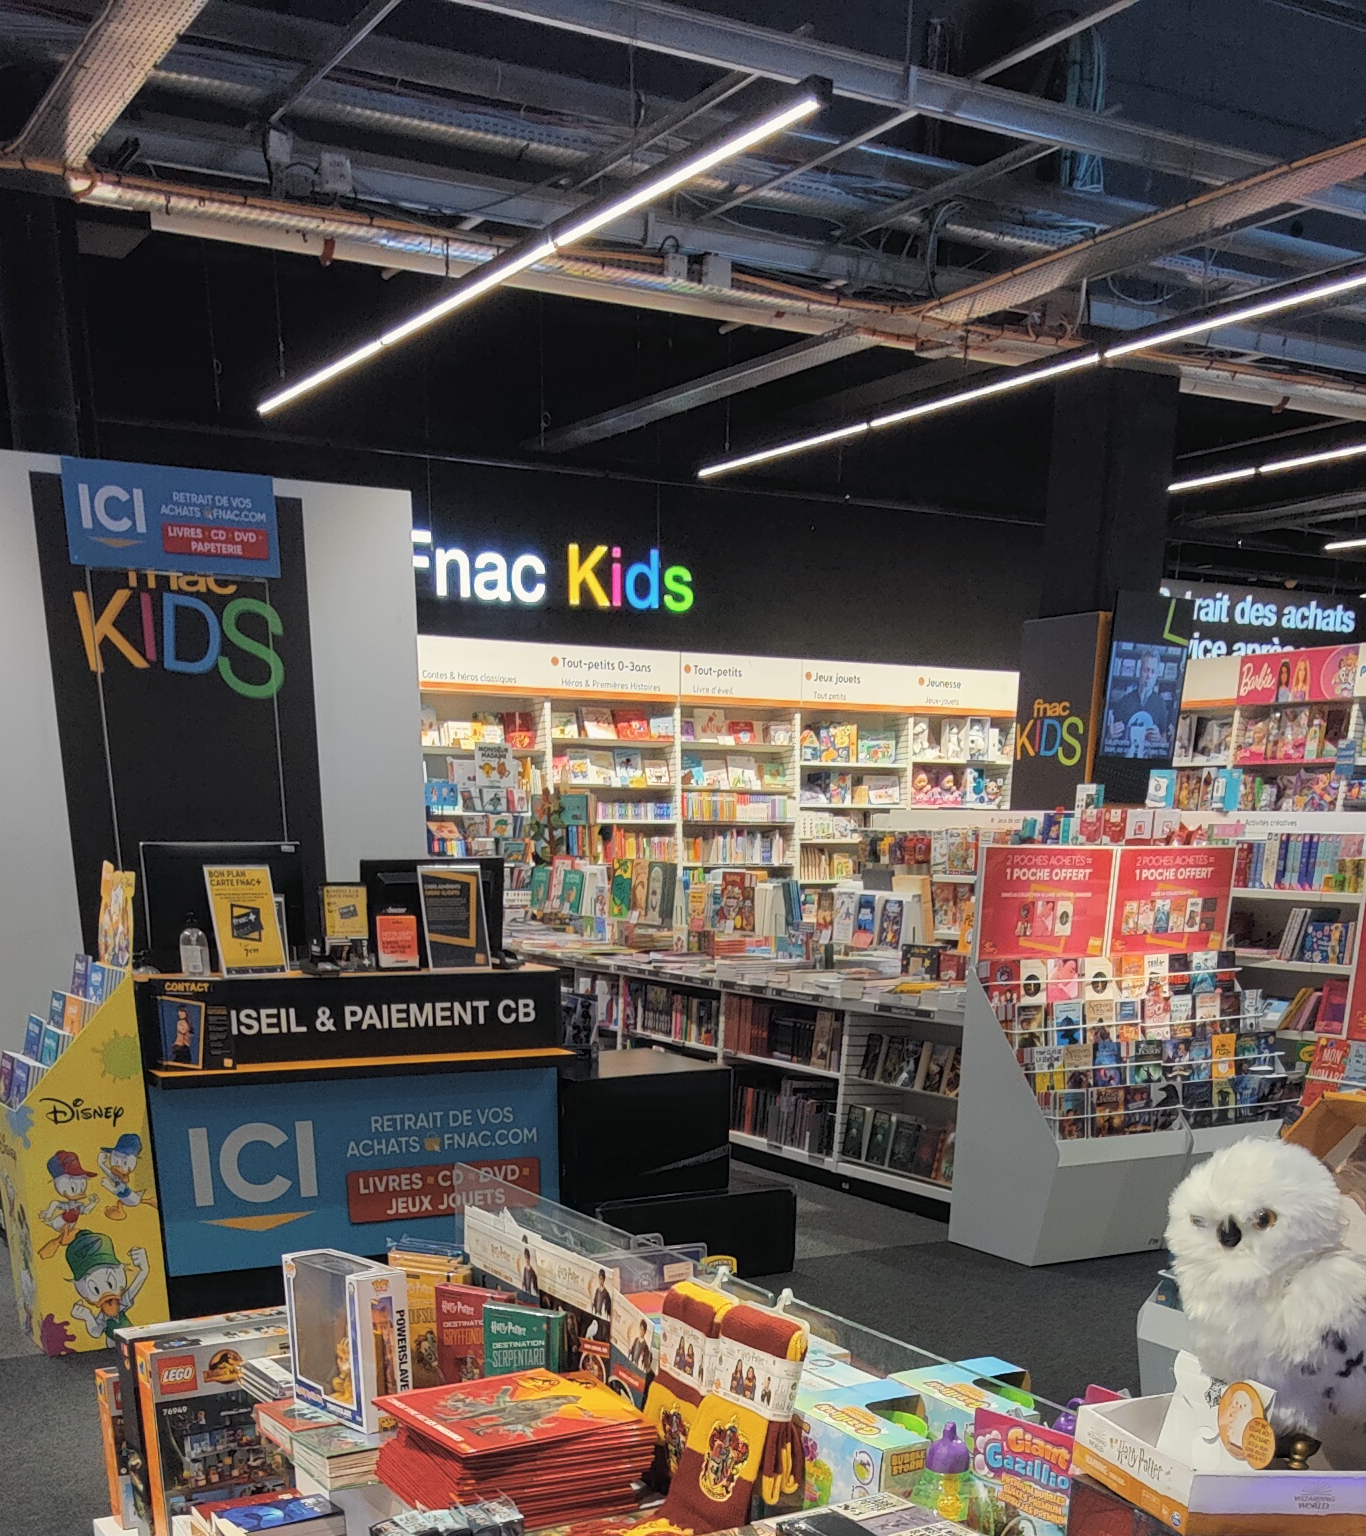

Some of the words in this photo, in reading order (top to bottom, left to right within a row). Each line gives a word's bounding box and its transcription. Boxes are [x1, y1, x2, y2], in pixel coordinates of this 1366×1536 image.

[78, 483, 146, 533] ICI
[173, 492, 212, 505] RETRAIT
[216, 495, 228, 506] DE
[230, 497, 252, 509] VOS
[160, 504, 201, 517] ACHATS
[213, 509, 267, 522] FNAC.COM
[168, 526, 202, 538] LIVRES
[211, 529, 226, 540] CD
[234, 531, 257, 542] DVD
[191, 541, 243, 555] PAPETERIE
[567, 543, 694, 613] Kids
[73, 589, 284, 698] KIDS
[561, 656, 615, 672] Tout-petits
[618, 661, 652, 673] 0-3ans
[693, 664, 743, 679] Tout-petits
[422, 670, 447, 679] Contes
[458, 672, 478, 681] héros
[480, 672, 517, 685] classiques
[561, 678, 582, 688] Héros
[585, 680, 591, 688] &
[593, 680, 629, 691] Premières
[631, 681, 661, 692] Histoires
[814, 671, 833, 684] Jeux
[835, 673, 861, 685] jouets
[925, 678, 962, 689] Jeunesse
[1239, 663, 1276, 697] Barbie
[1034, 699, 1070, 718] fnac
[1015, 716, 1084, 766] KIDS
[1006, 855, 1012, 865] 2
[1014, 855, 1048, 865] POCHES
[1049, 854, 1085, 865] ACHETÉS
[1136, 855, 1142, 866] 2
[1143, 856, 1175, 866] POCHES
[1176, 854, 1208, 865] ACHETÉS
[209, 869, 224, 878] BON
[226, 870, 246, 878] PLAN
[1006, 868, 1012, 880] 1
[1013, 868, 1050, 881] POCHE
[1052, 868, 1093, 881] OFFERT
[1135, 869, 1140, 881] 1
[1142, 868, 1176, 881] POCHE
[1178, 867, 1214, 879] OFFERT
[210, 878, 234, 887] CARTE
[236, 878, 262, 887] FNAC+
[165, 981, 209, 992] CONTACT
[315, 1007, 336, 1032] &
[344, 1000, 489, 1031] PAIEMENT
[497, 999, 535, 1024] CB
[39, 1098, 124, 1127] Disney
[371, 1111, 442, 1133] RETRAIT
[449, 1109, 472, 1126] DE
[477, 1106, 513, 1124] VOS
[347, 1136, 420, 1158] ACHATS
[444, 1127, 537, 1150] FNAC.COM
[187, 1120, 318, 1207] ICI
[359, 1173, 422, 1195] LIVRES
[437, 1170, 463, 1187] CD
[479, 1164, 520, 1184] DVD
[387, 1197, 431, 1215] JEUX
[438, 1189, 505, 1209] JOUETS
[395, 1309, 410, 1391] POWERSLAVE
[492, 1340, 545, 1348] DESTINATION
[493, 1348, 545, 1368] SERPENTARD
[161, 1367, 193, 1386] LEGO
[162, 1405, 188, 1416] 76949
[1007, 1428, 1073, 1470] Giant
[890, 1450, 925, 1466] BUBBLE
[985, 1442, 1070, 1491] Gazillio
[1116, 1439, 1138, 1468] Harry
[1138, 1448, 1164, 1481] Potter
[891, 1460, 924, 1476] STORM
